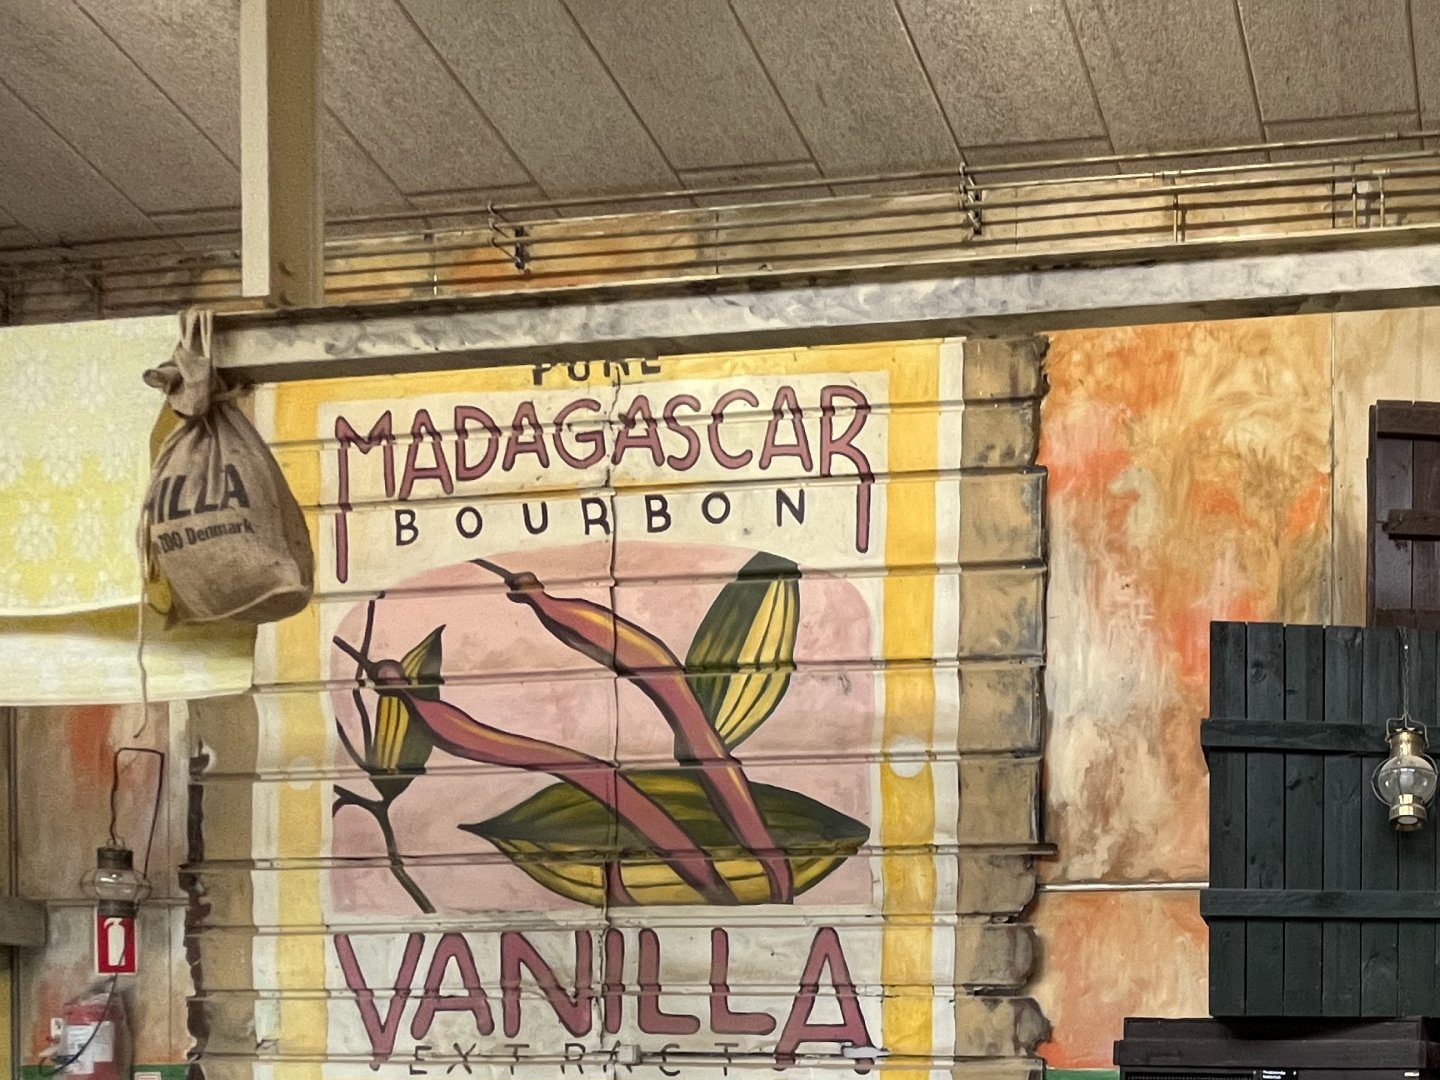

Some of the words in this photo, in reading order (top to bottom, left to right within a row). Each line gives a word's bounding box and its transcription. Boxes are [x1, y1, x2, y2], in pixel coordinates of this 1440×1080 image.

[146, 463, 250, 525] ILLA
[335, 384, 875, 583] MADAGASCAR
[185, 518, 255, 545] Denmark
[396, 488, 806, 546] BOURBON
[334, 926, 879, 1074] VANILLA
[409, 1040, 740, 1077] EXTRACT
